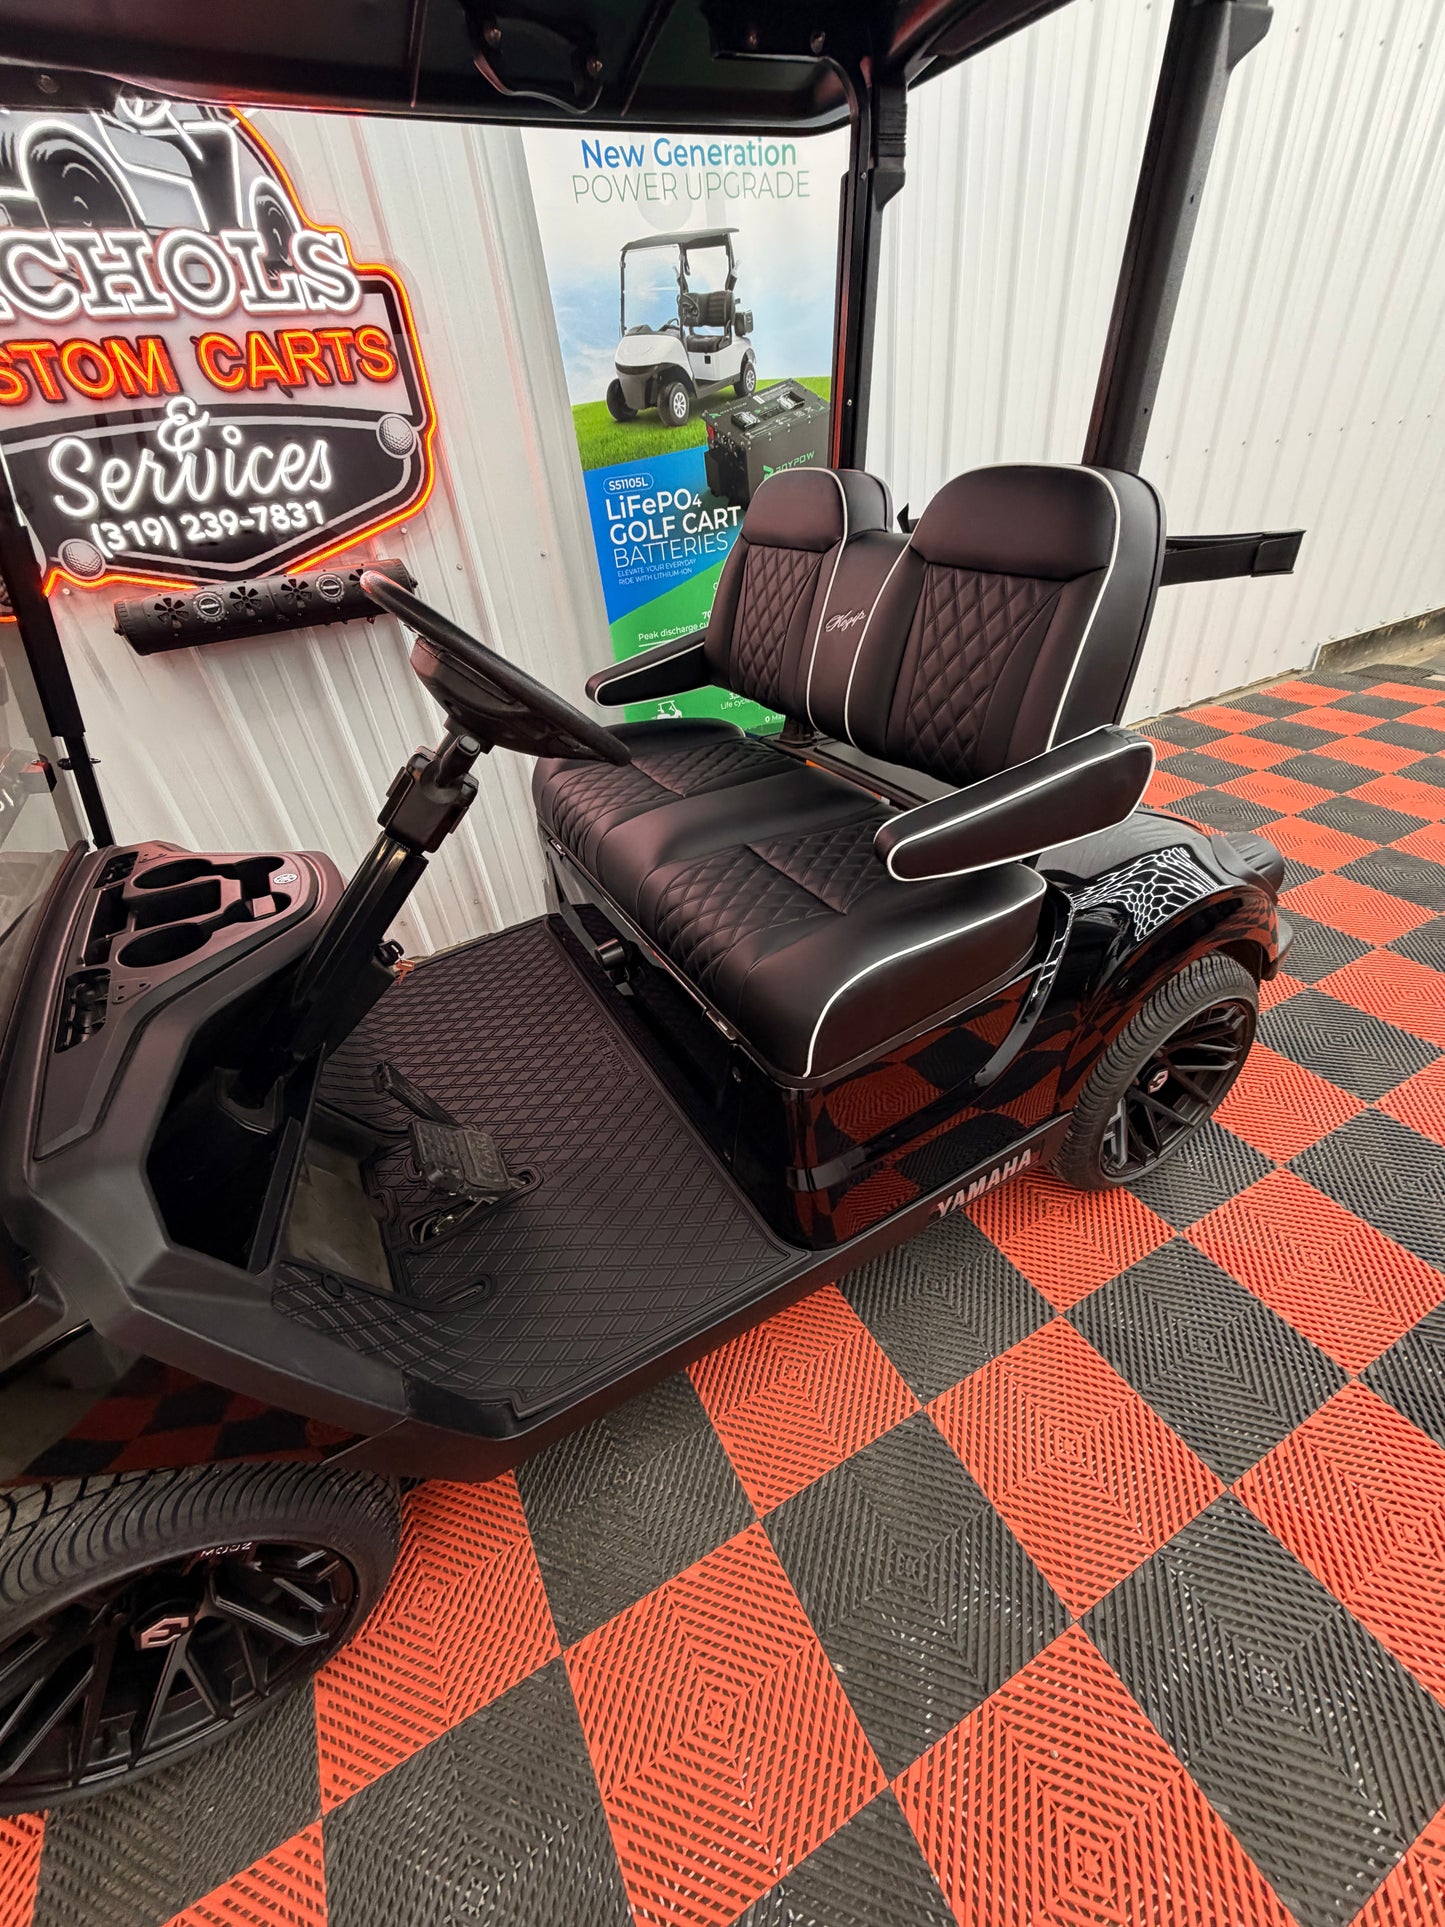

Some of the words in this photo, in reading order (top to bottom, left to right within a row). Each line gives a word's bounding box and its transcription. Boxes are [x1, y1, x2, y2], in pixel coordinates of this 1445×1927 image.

[581, 138, 645, 169] New
[653, 136, 796, 167] Generation
[572, 173, 678, 204] POWER
[685, 170, 811, 200] UPGRADE
[0, 228, 361, 322] CHOLS
[197, 326, 397, 393] CARTS
[157, 396, 210, 462] &
[49, 424, 332, 517] Services
[608, 476, 649, 491] S51105L
[91, 515, 178, 559] (319)
[180, 500, 324, 541] 239-7831
[610, 516, 676, 545] GOLF
[682, 505, 742, 534] CART
[613, 531, 729, 569] BATTERIES
[617, 566, 645, 578] ELEVATE
[646, 563, 665, 573] YOUR
[666, 558, 697, 570] EVERYDAY
[618, 576, 635, 585] RIDE
[635, 573, 653, 583] WITH
[638, 631, 659, 641] Peak
[660, 623, 698, 637] discharge
[720, 701, 733, 710] Life
[937, 1148, 1032, 1218] YAMAHA
